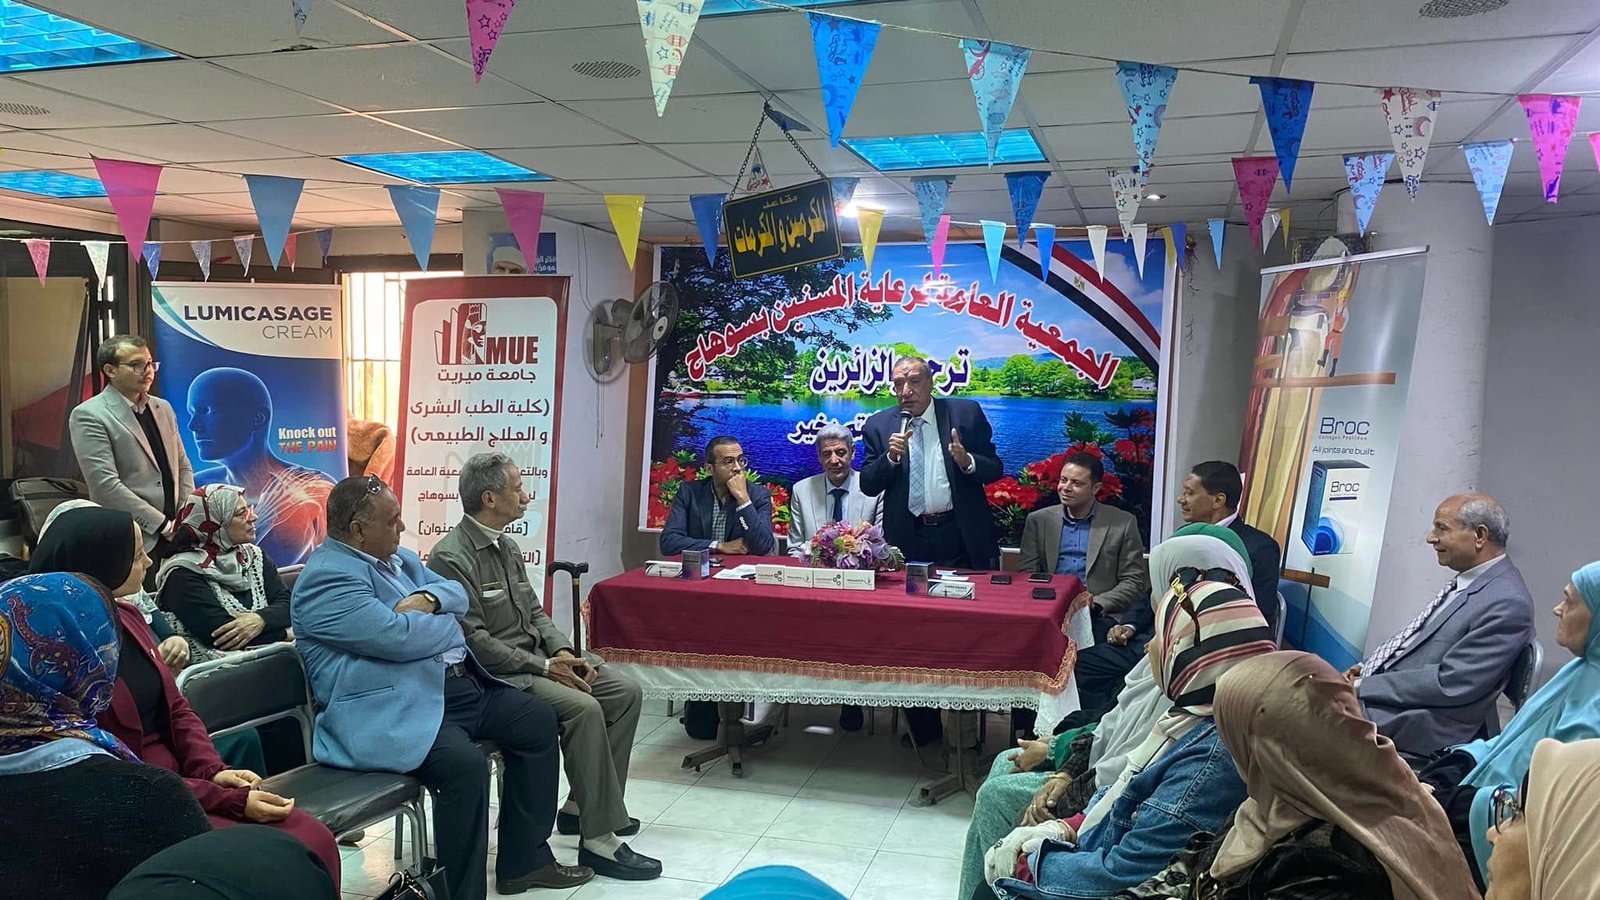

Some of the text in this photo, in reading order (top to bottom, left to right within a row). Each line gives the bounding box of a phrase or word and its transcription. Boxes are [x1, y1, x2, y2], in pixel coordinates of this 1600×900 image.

[762, 194, 798, 209] مقاعد
[771, 273, 854, 333] المسنين
[936, 274, 1015, 328] العامة
[184, 305, 333, 321] LUMICASAGE
[262, 325, 333, 340] CREAM
[486, 336, 539, 365] MUE
[685, 305, 770, 381] بسوهاج
[1014, 299, 1120, 389] الجمعية
[437, 368, 536, 385] جامعة ميريت
[927, 347, 972, 395] ترح
[465, 399, 504, 418] الطب
[278, 427, 337, 439] Knock out
[1320, 416, 1371, 435] Broc
[488, 426, 536, 448] العلاج
[278, 440, 337, 453] THE PAIN
[1321, 446, 1341, 455] joints
[1354, 447, 1375, 456] built
[406, 466, 437, 476] العامة
[1330, 481, 1360, 493] Broc
[417, 490, 459, 503] بسوهاج
